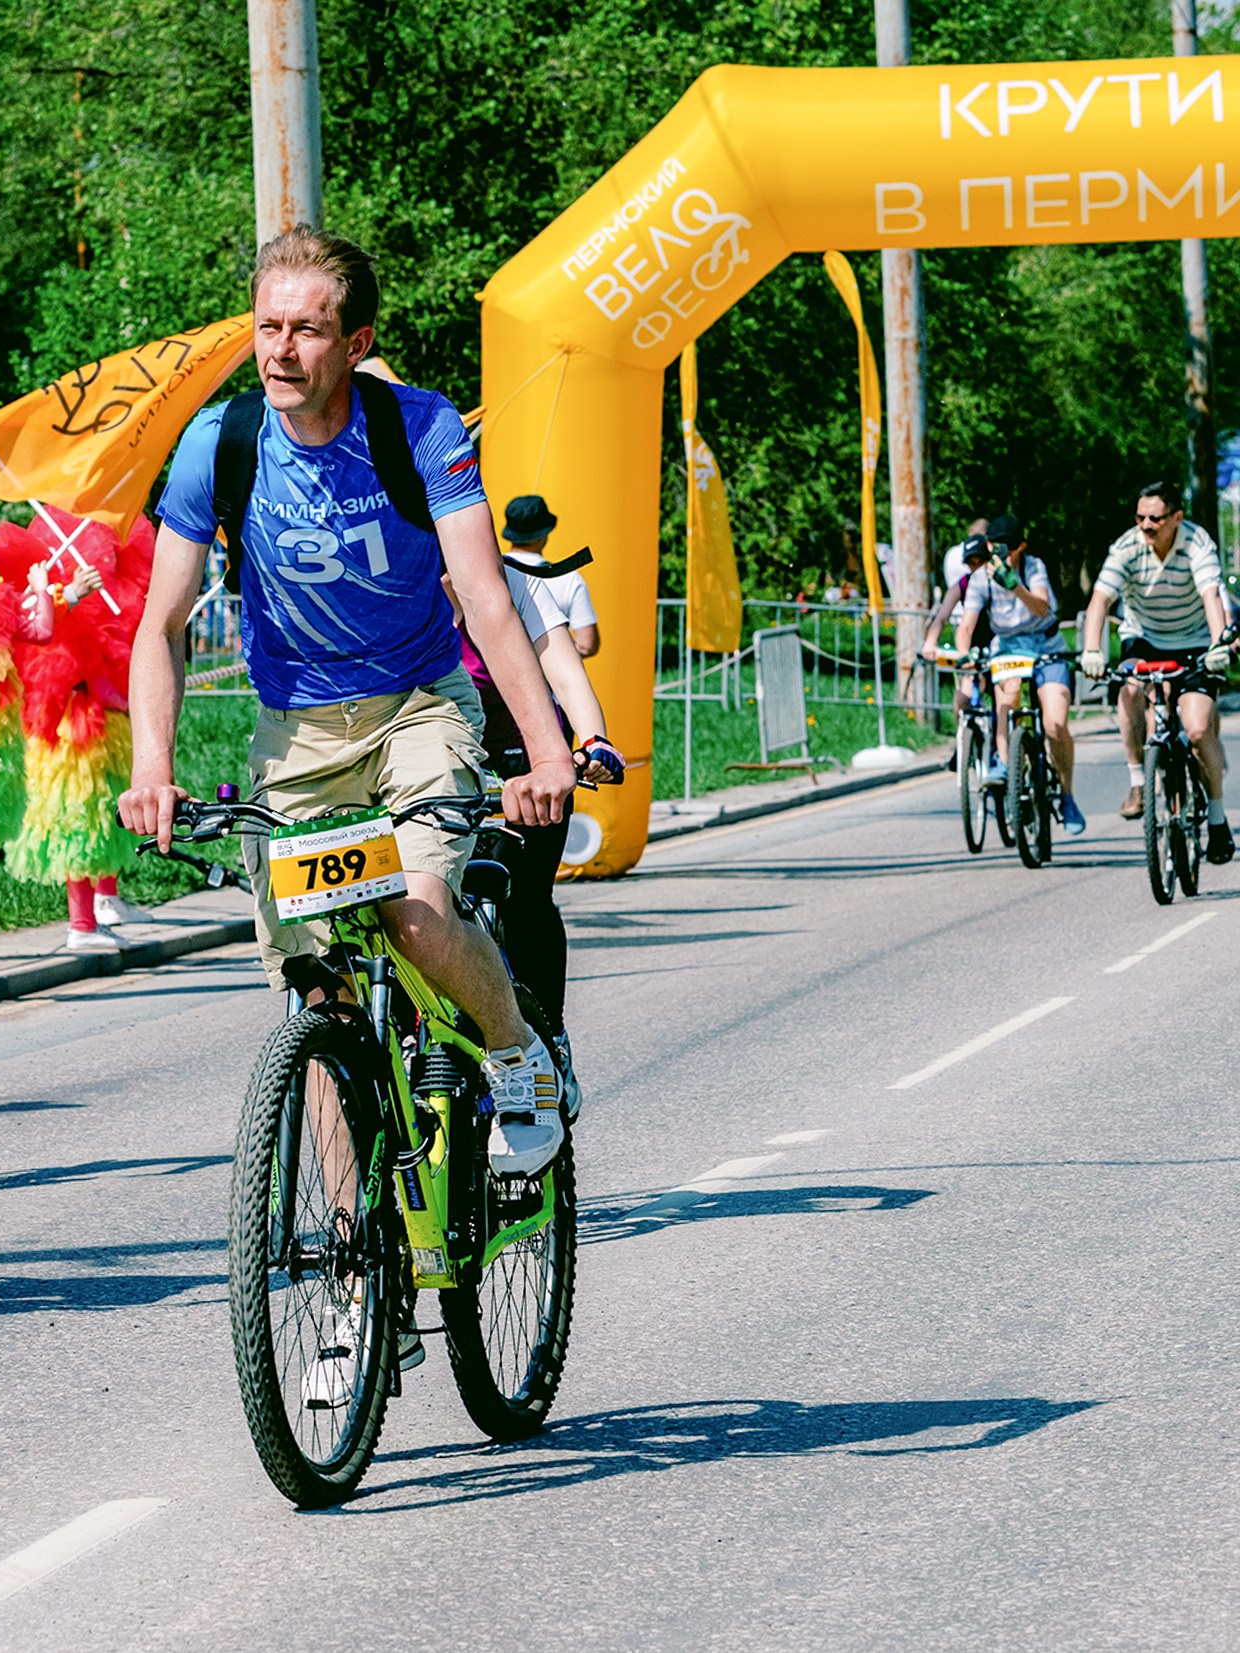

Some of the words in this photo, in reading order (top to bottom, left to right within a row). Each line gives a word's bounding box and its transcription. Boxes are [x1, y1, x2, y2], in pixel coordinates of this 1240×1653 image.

[939, 69, 1224, 139] КРУТИ
[560, 157, 687, 281] ПЕРМСКИЙ
[875, 182, 927, 234] В
[258, 490, 390, 519] ГИМНАЗИЯ
[274, 519, 390, 584] 31
[297, 849, 367, 890] 789
